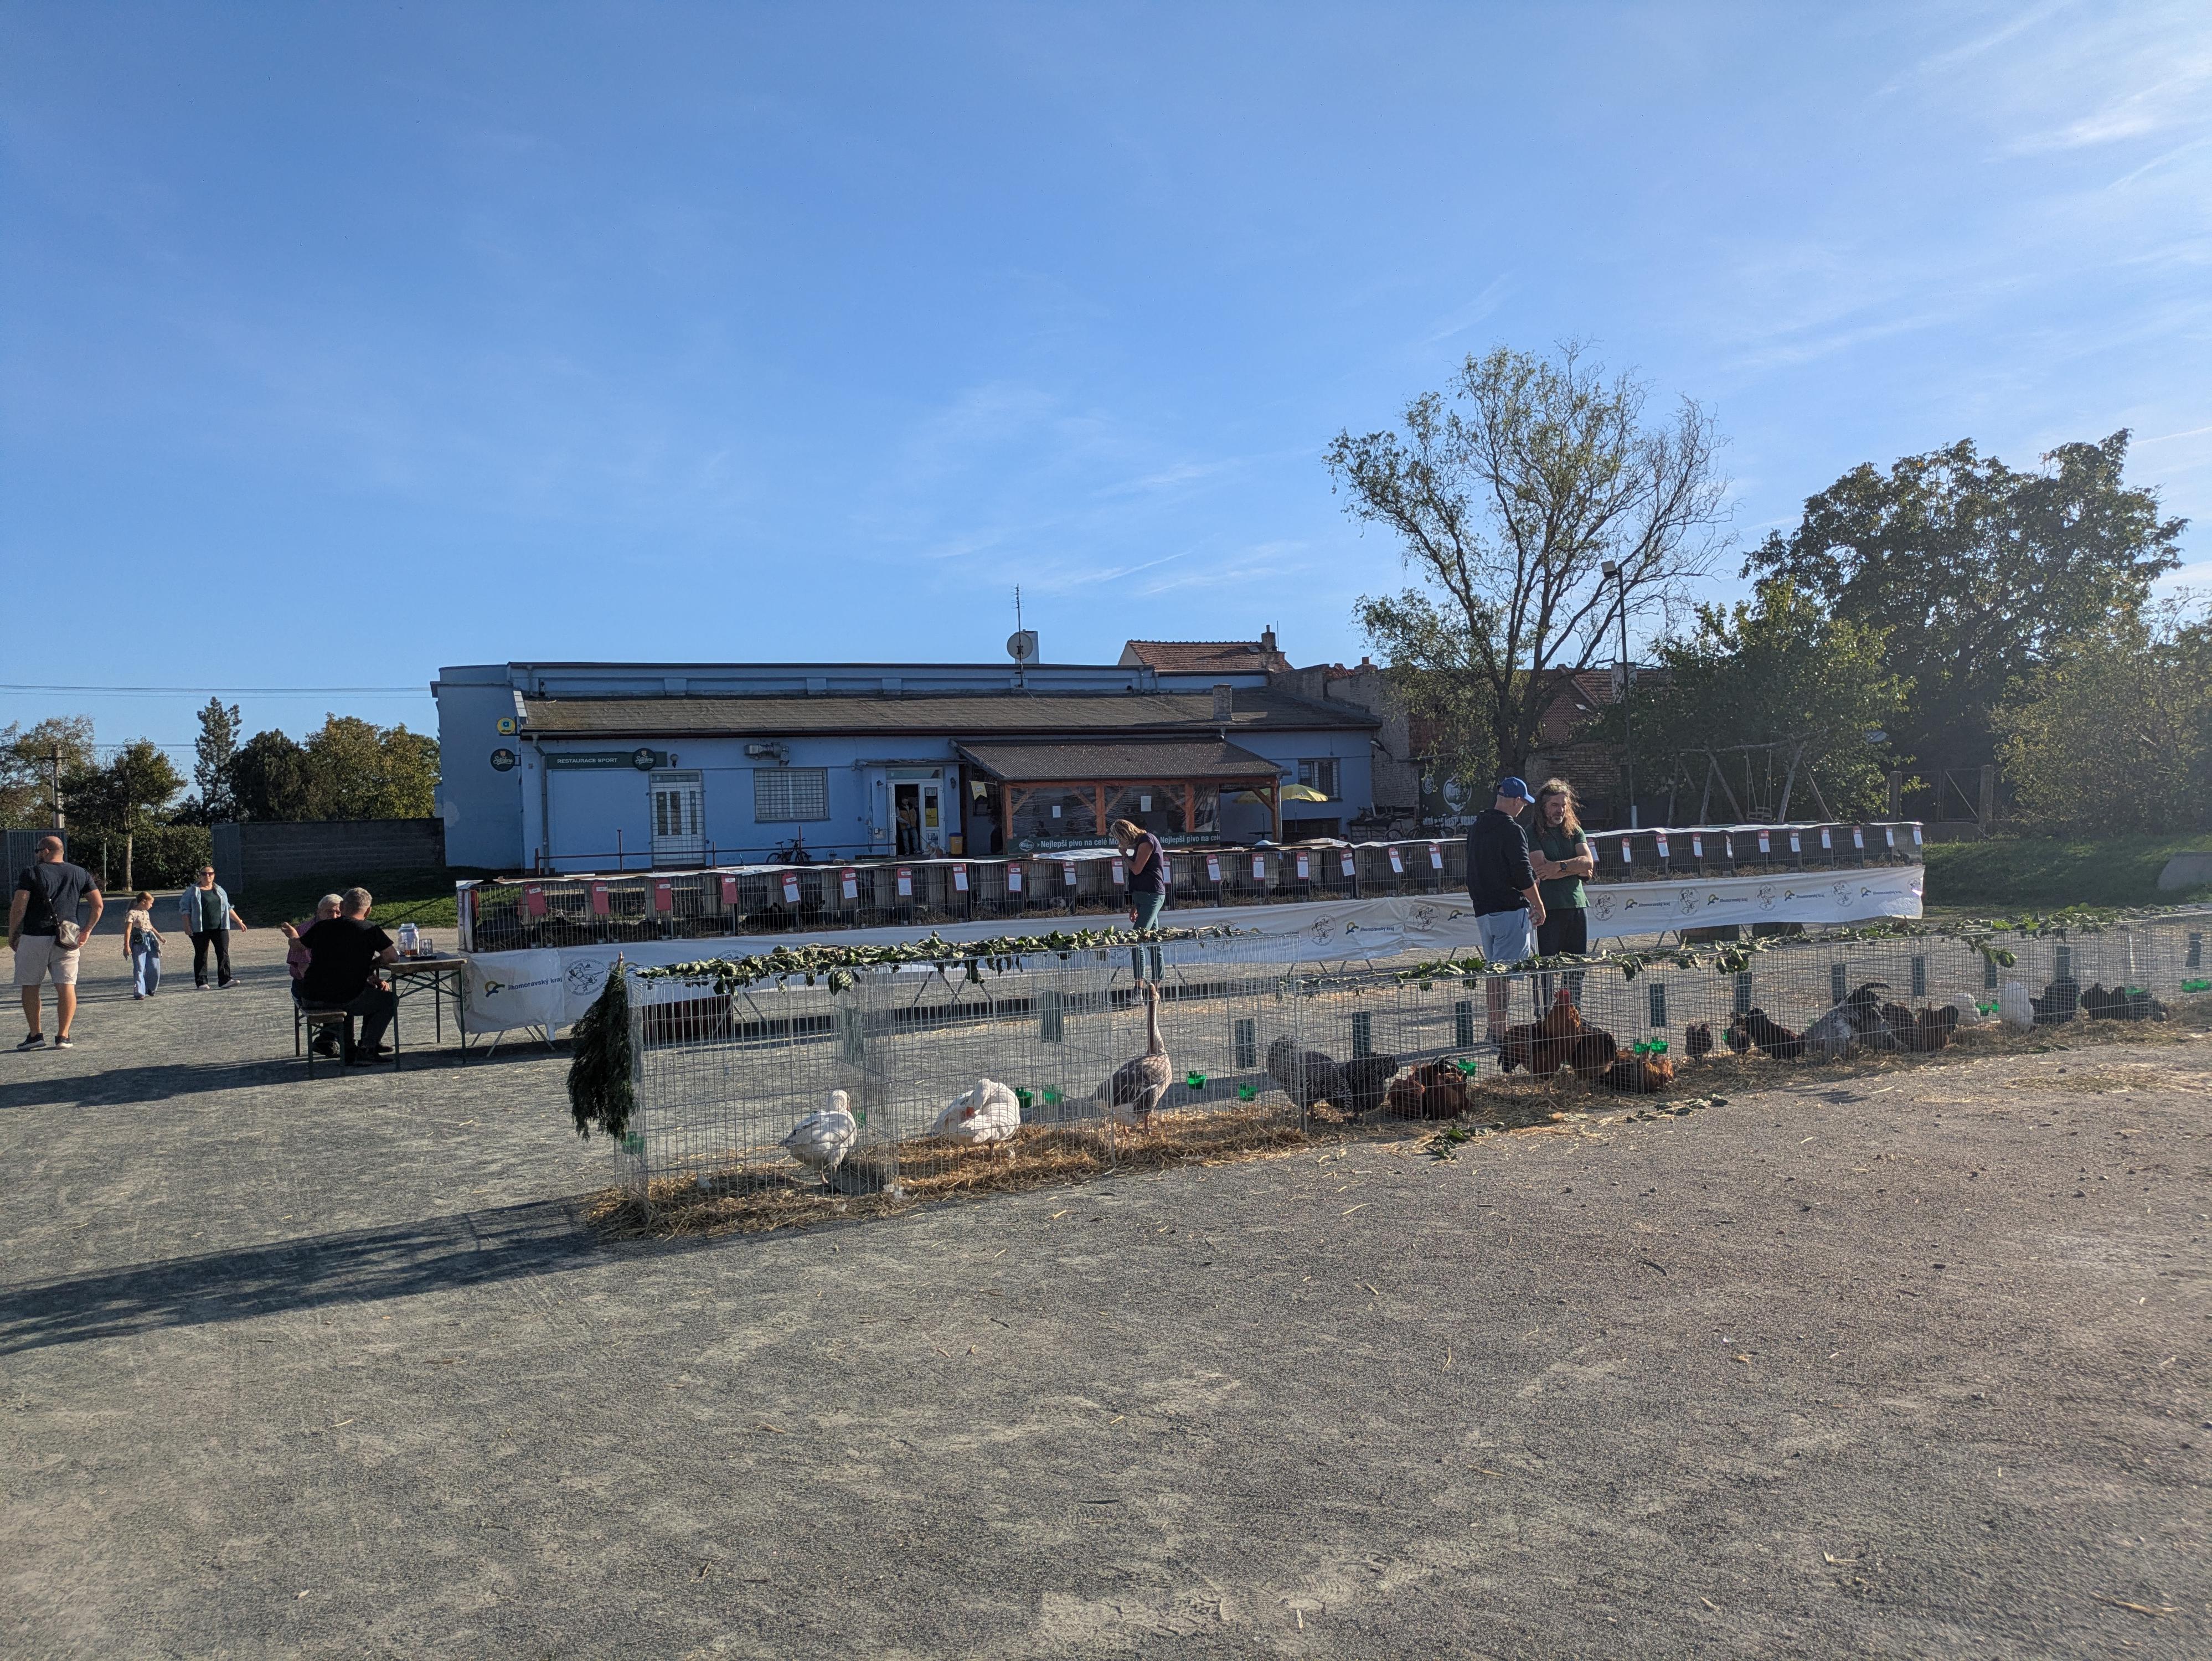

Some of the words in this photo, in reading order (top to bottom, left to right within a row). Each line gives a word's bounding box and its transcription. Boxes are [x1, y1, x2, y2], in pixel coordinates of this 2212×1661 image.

[1040, 839, 1068, 849] Nejlepší
[1069, 839, 1082, 848] pivo
[1160, 835, 1185, 844] Nejlepší
[1187, 835, 1199, 843] pivo
[508, 979, 549, 991] Jihomoravský
